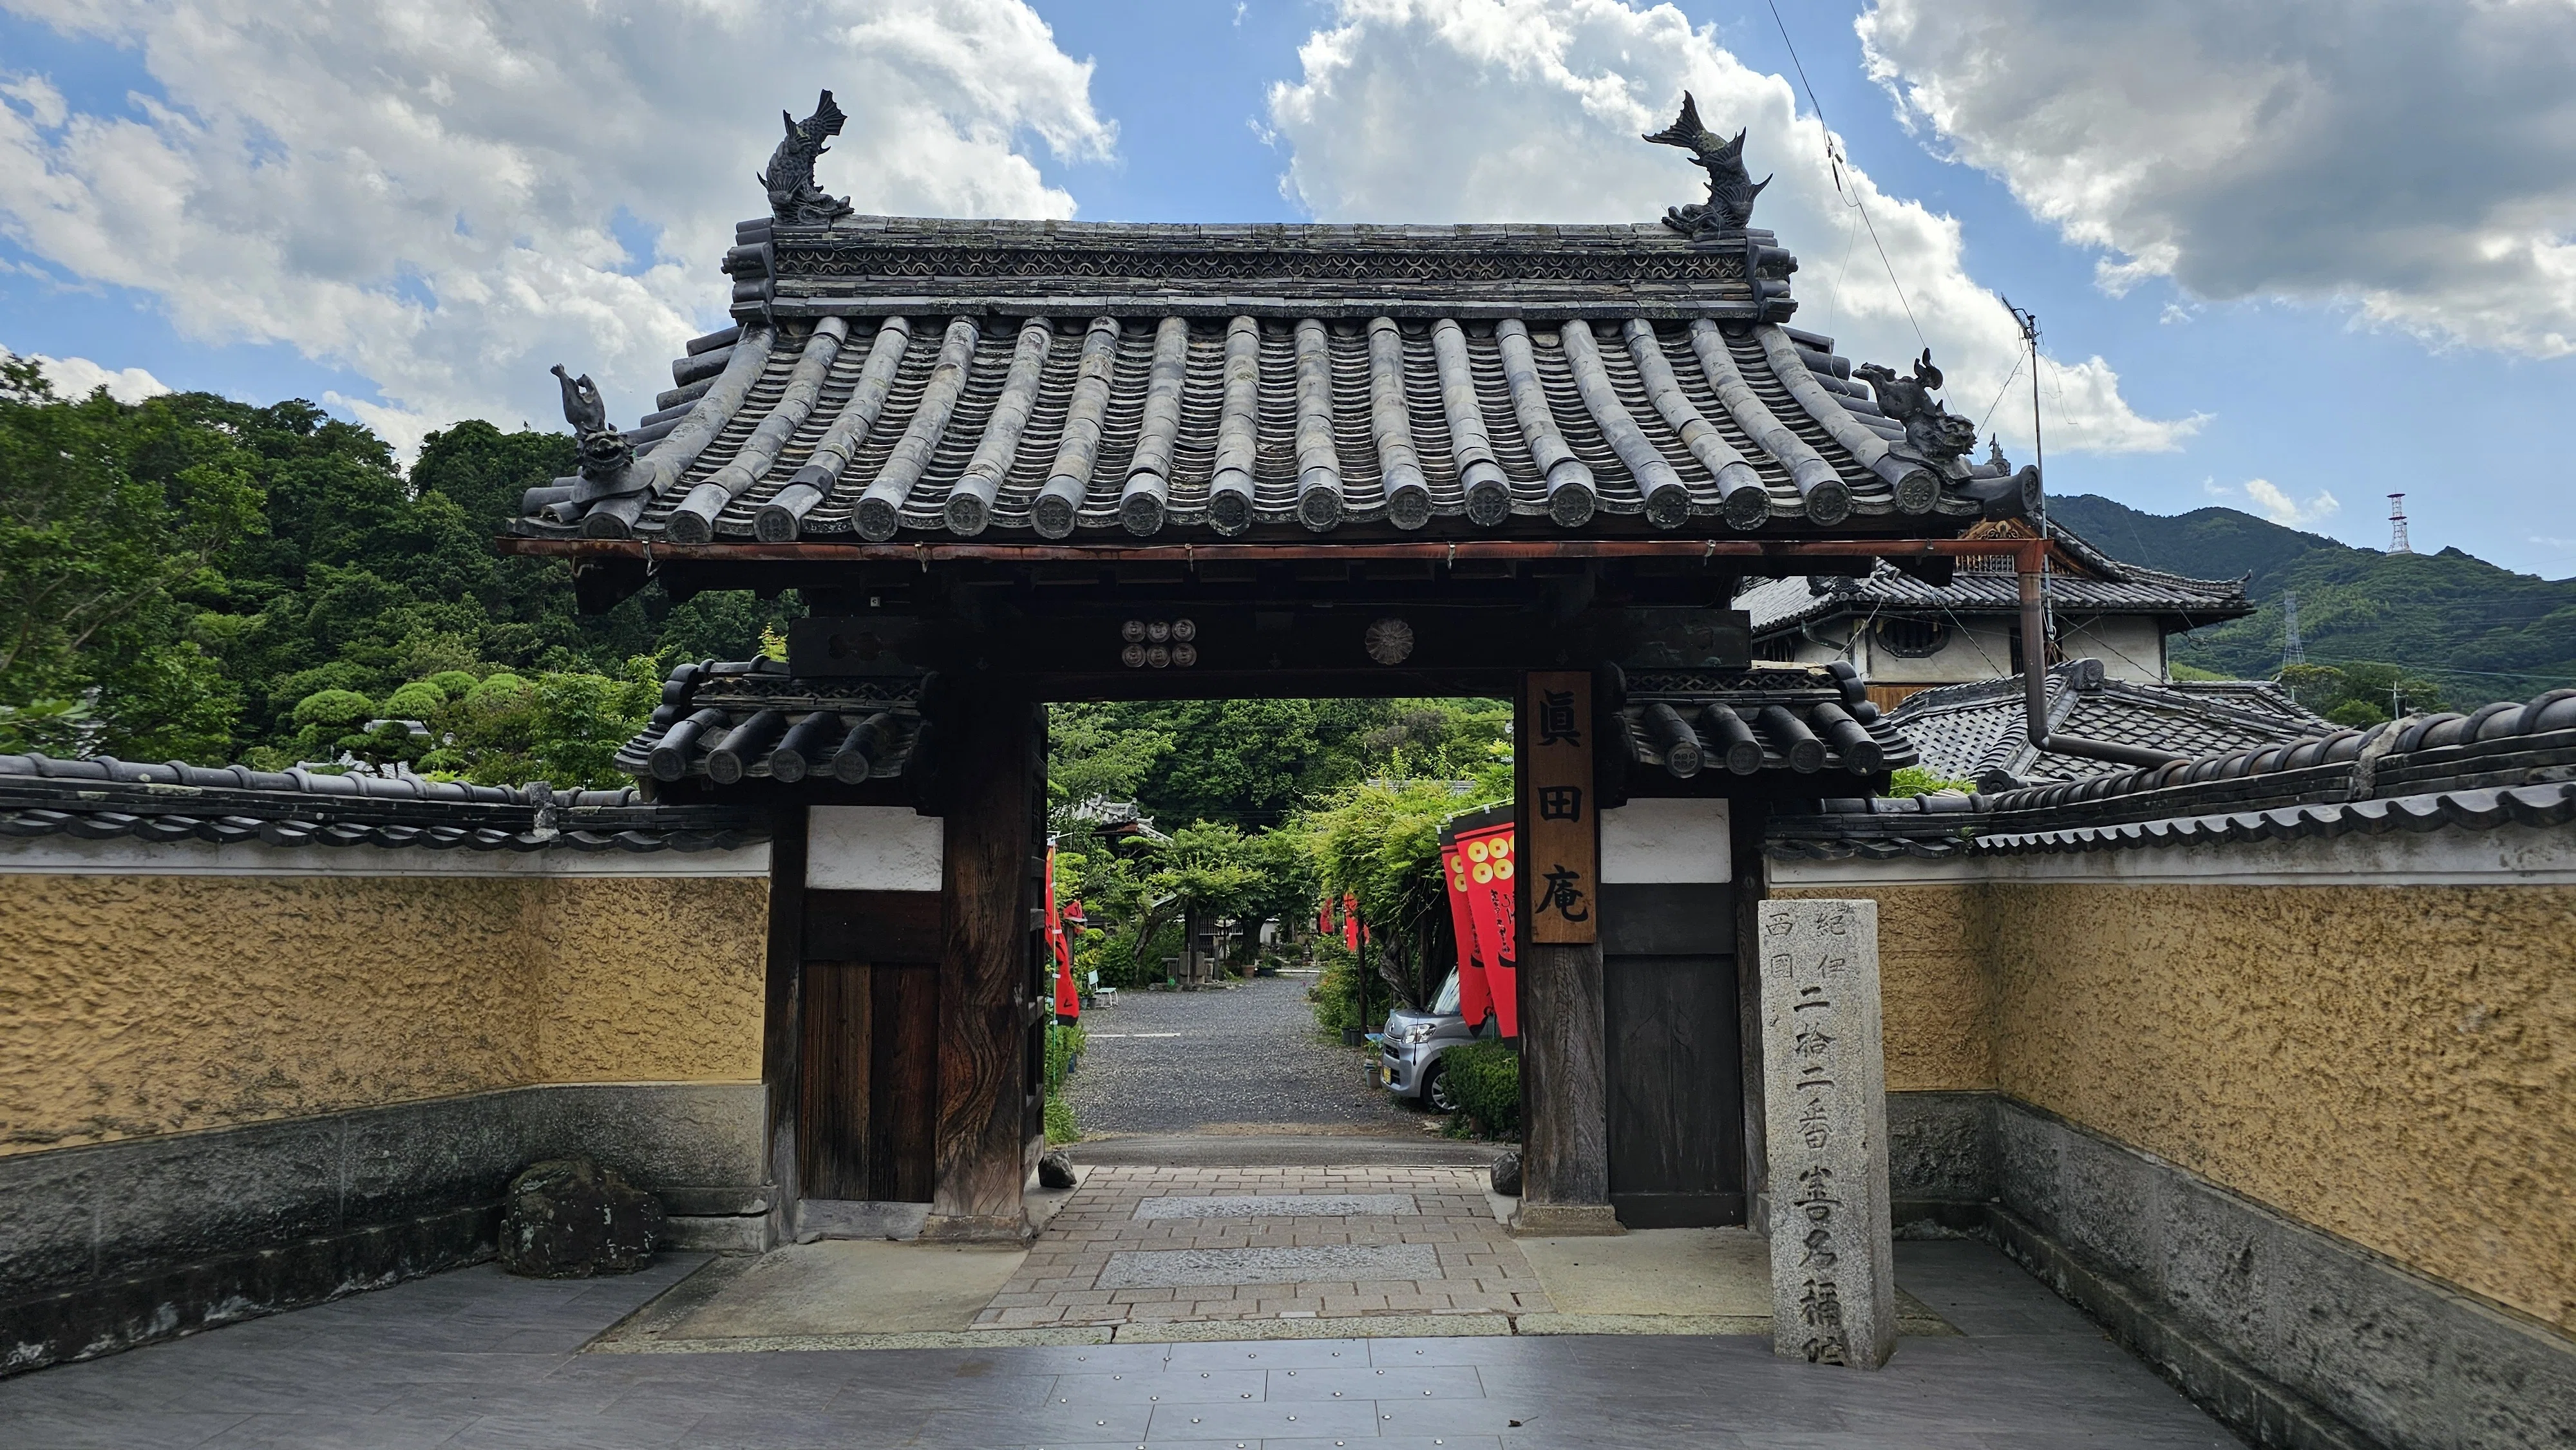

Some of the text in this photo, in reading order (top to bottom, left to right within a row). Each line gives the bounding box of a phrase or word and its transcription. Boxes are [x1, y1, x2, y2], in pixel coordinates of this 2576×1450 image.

[1535, 690, 1589, 921] 眞田庵
[1816, 913, 1846, 980] 紀伊
